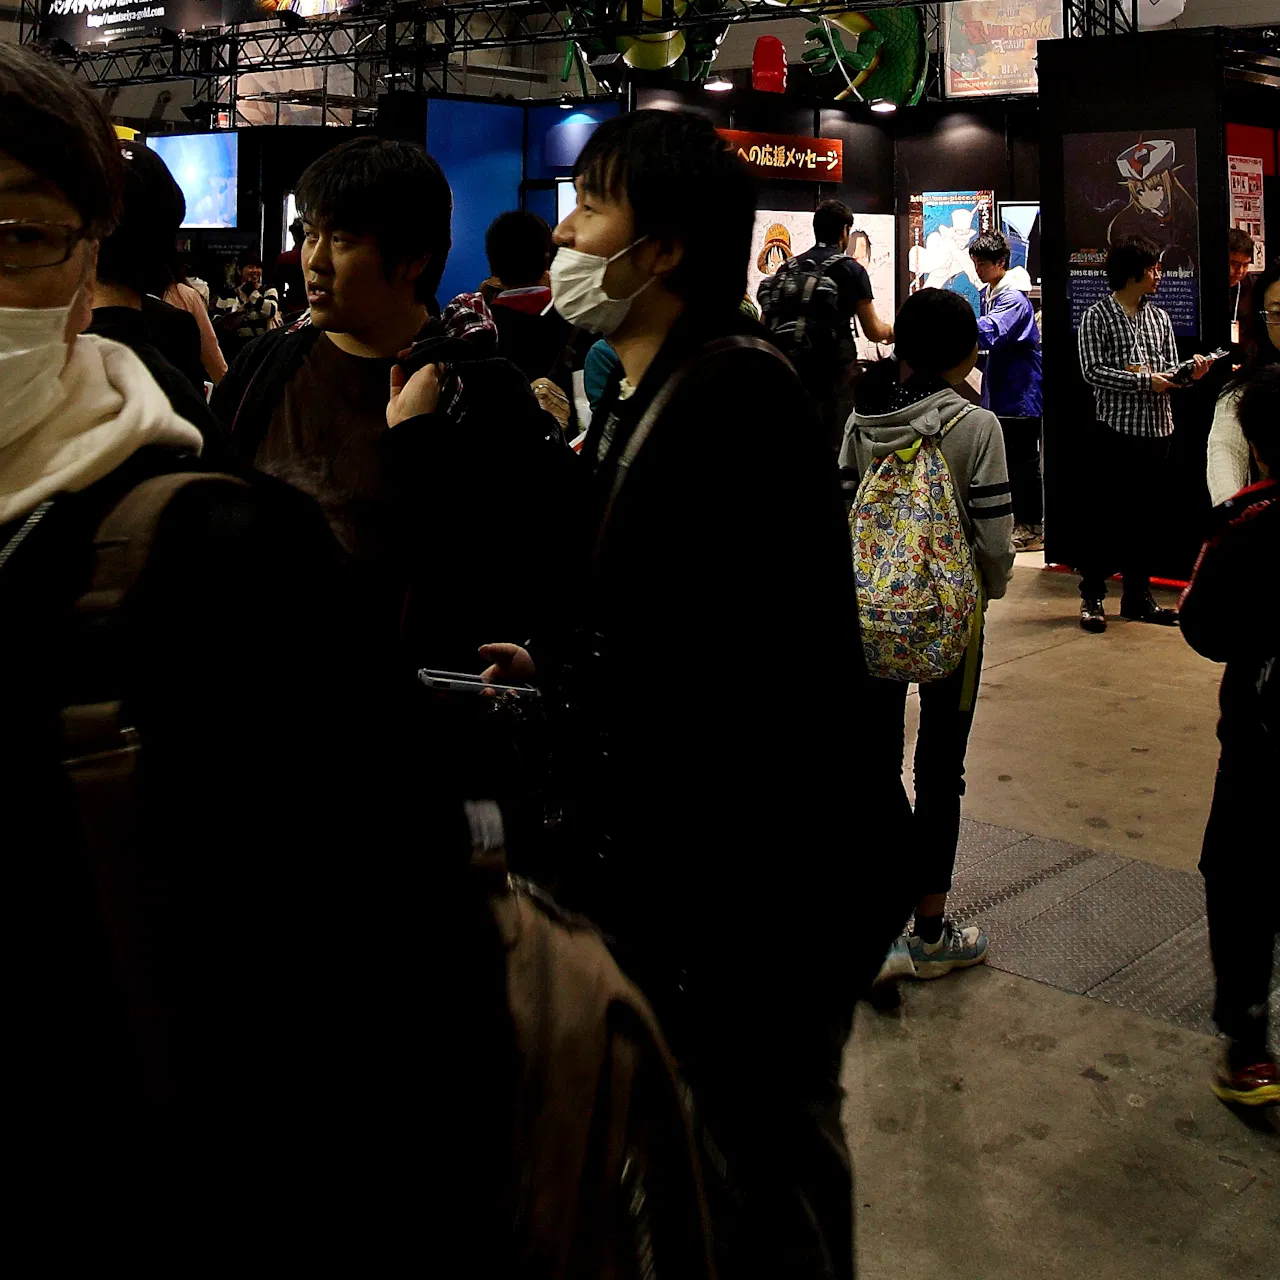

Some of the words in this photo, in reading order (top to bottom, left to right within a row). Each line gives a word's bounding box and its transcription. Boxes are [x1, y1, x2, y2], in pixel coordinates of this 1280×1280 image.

[737, 143, 839, 170] への応援メッセージ
